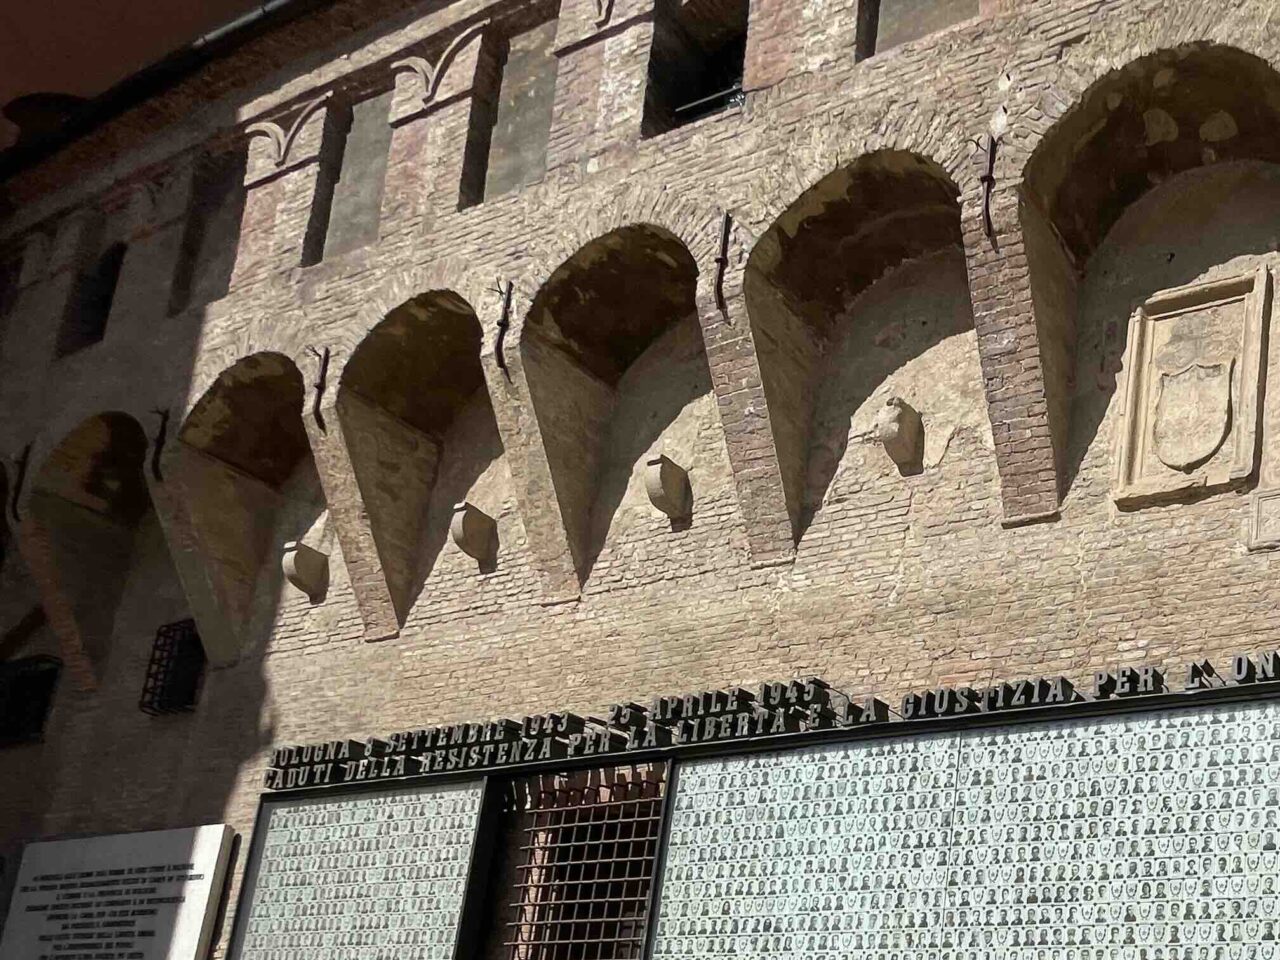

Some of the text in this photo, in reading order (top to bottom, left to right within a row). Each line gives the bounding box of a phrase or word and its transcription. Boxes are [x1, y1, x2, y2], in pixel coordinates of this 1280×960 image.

[264, 762, 334, 789] CADUTI
[344, 755, 405, 781] DELLA
[419, 737, 552, 773] RESISTENZA
[568, 730, 611, 755] PER
[626, 720, 656, 749] LA
[810, 703, 822, 728] E
[842, 696, 877, 725] LA
[1093, 665, 1155, 696] PER
[270, 740, 349, 767] BOLOGNA
[364, 736, 374, 757] 8
[385, 718, 507, 753] SETTEMBRE
[520, 710, 569, 737] 1943
[607, 702, 633, 725] 25
[649, 688, 739, 721] APRILE
[758, 677, 815, 706] 1945
